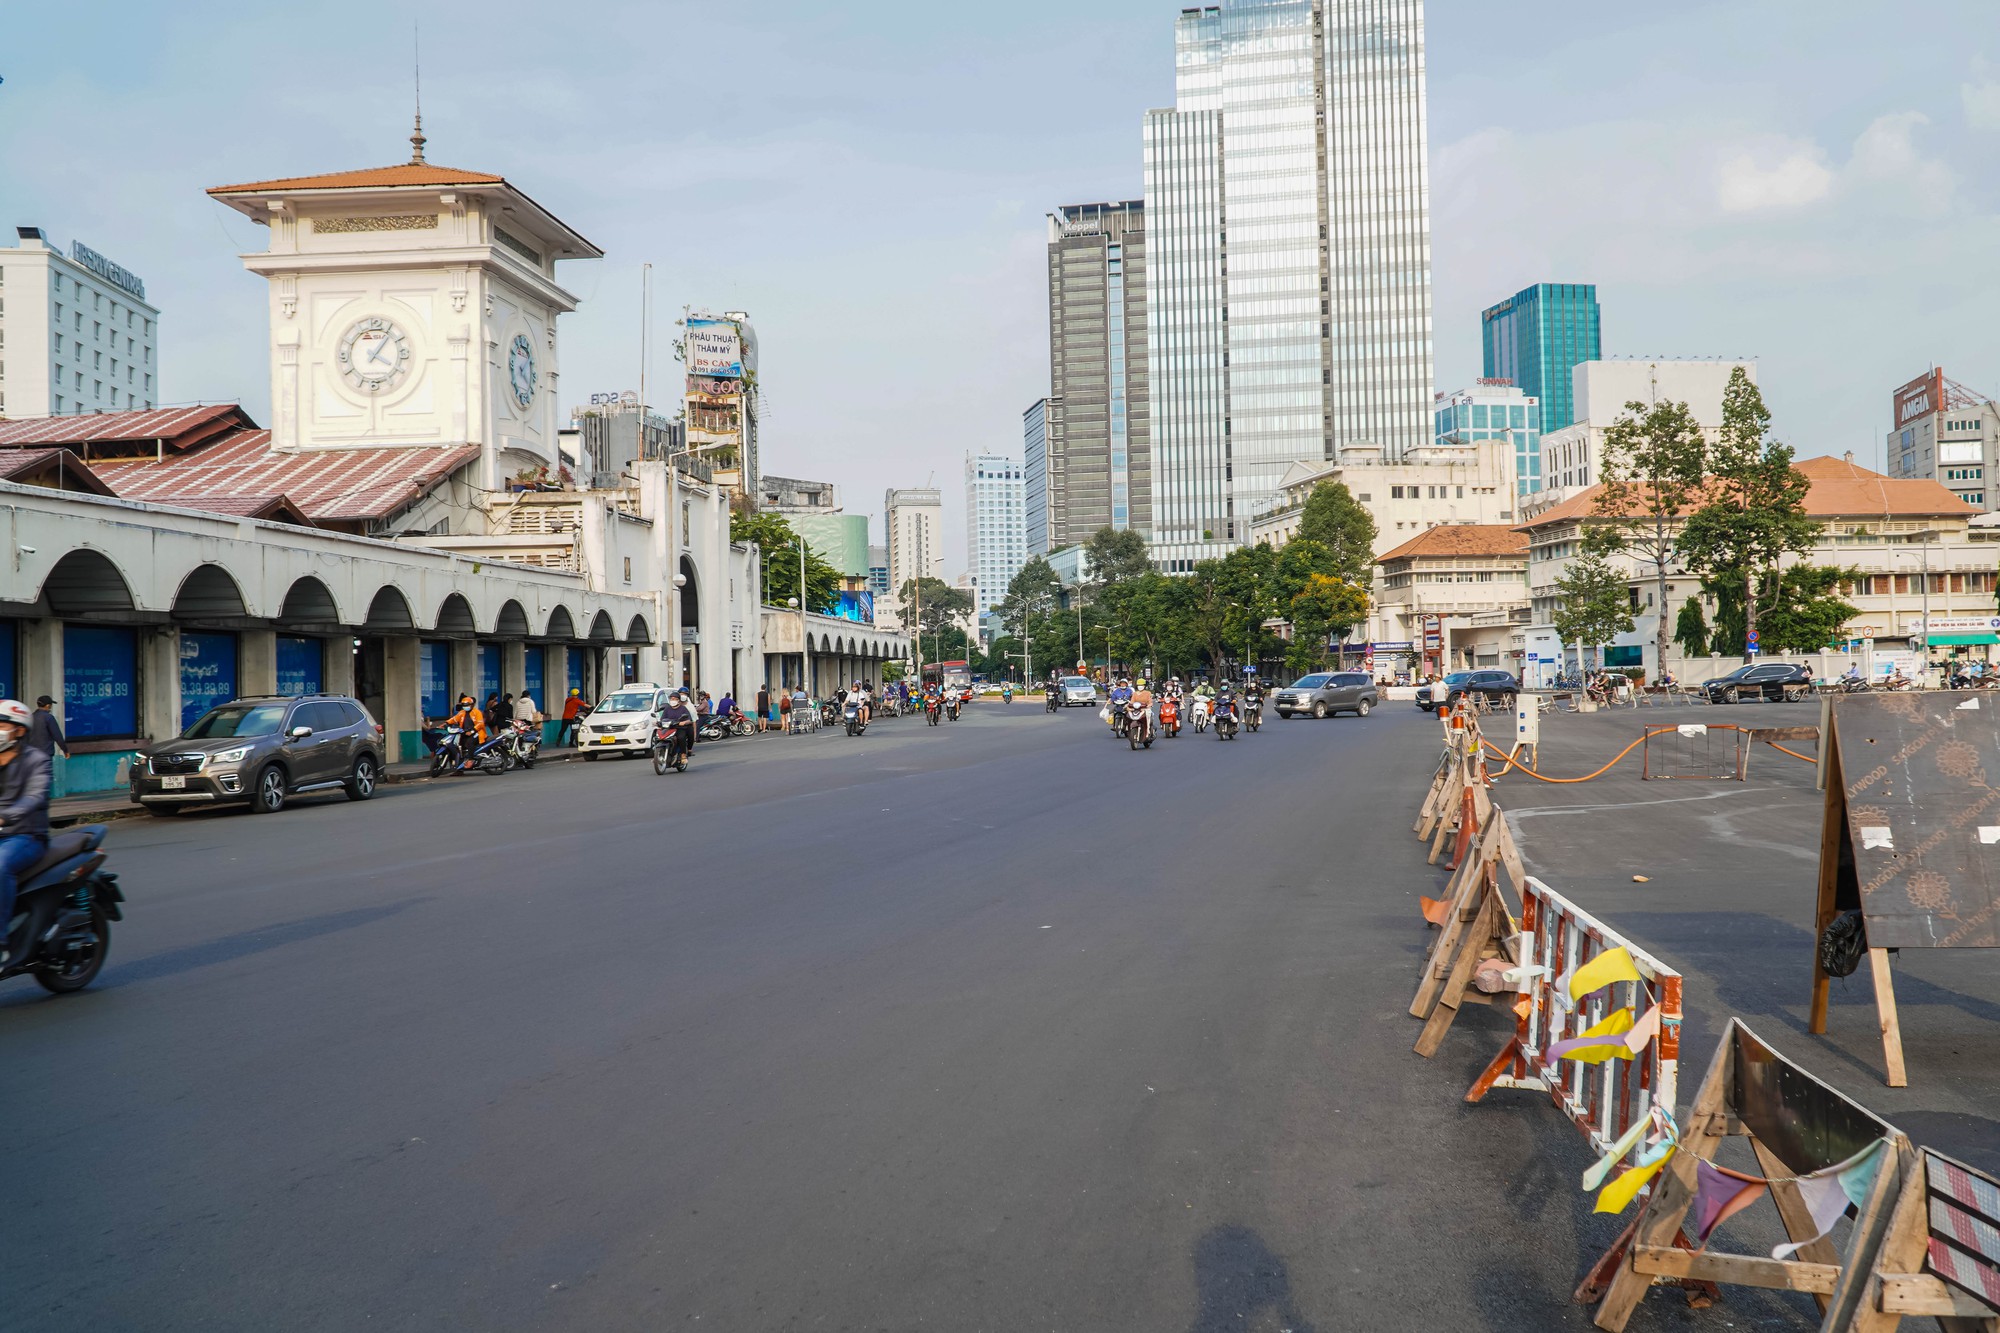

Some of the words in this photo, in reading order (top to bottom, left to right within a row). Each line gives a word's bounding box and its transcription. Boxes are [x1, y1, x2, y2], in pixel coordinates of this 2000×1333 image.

[1064, 219, 1099, 232] Keppel
[696, 358, 709, 366] BS
[1476, 377, 1514, 386] SUNWAH
